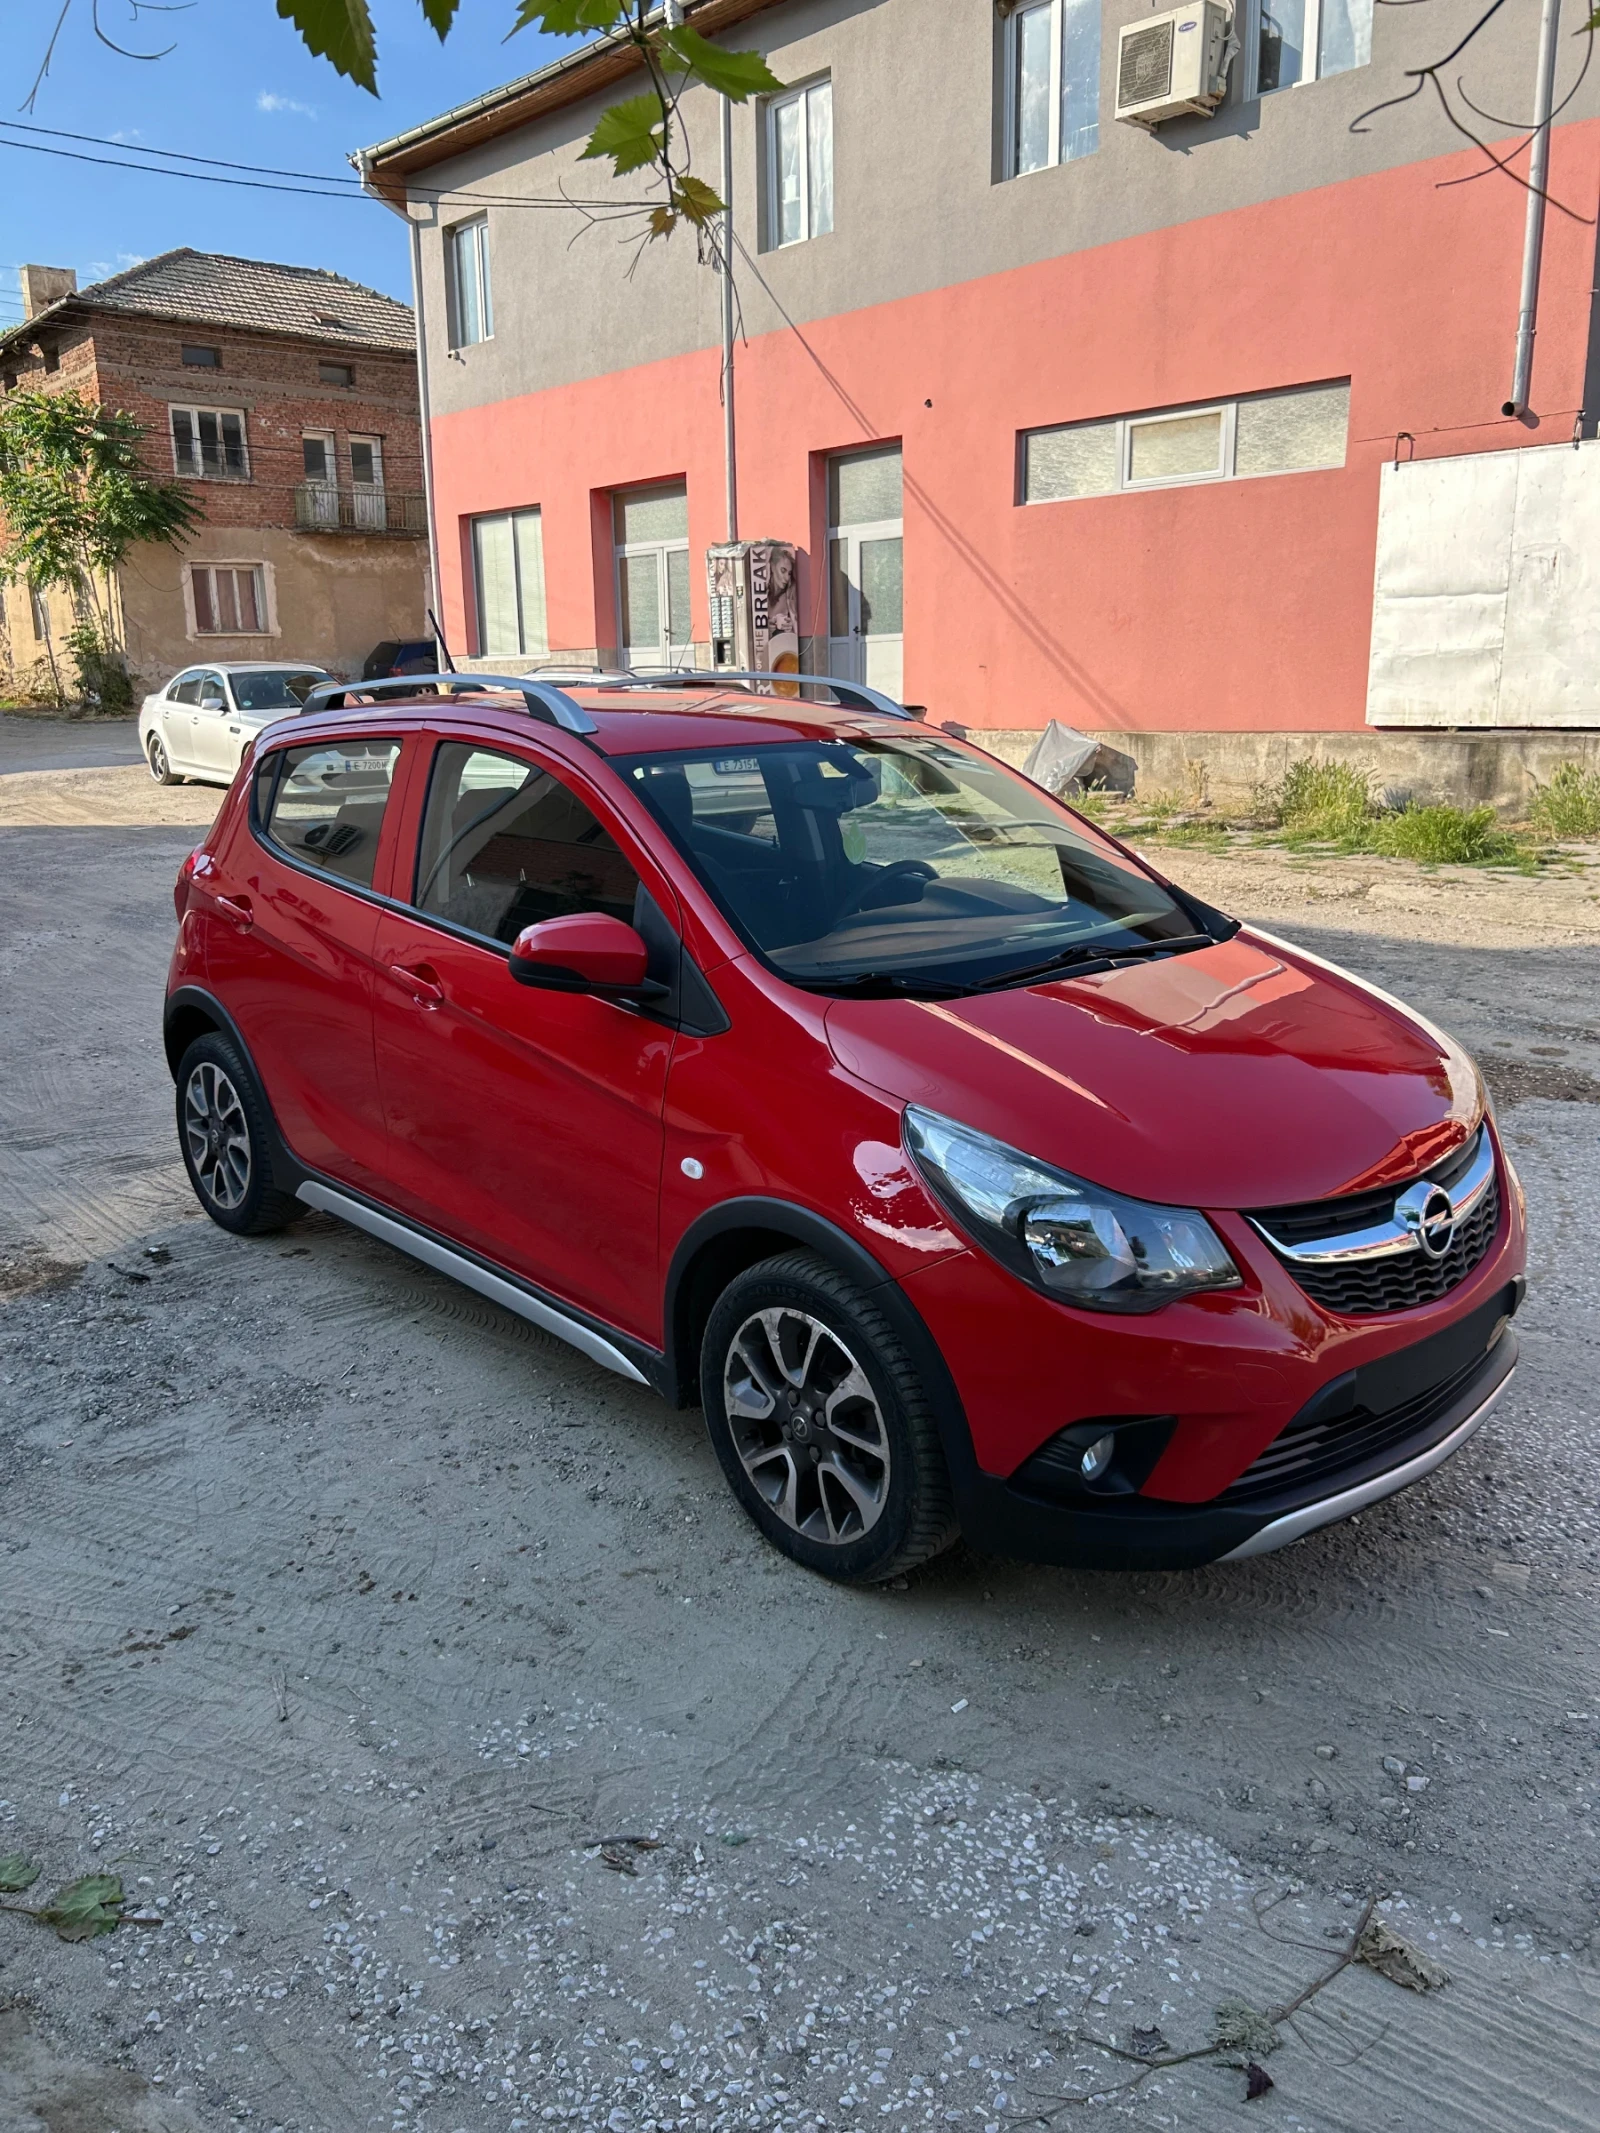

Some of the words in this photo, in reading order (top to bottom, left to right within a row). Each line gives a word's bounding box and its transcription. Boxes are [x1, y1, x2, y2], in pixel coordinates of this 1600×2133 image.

[752, 547, 769, 629] BREAK
[755, 630, 764, 656] THE
[724, 761, 730, 771] E
